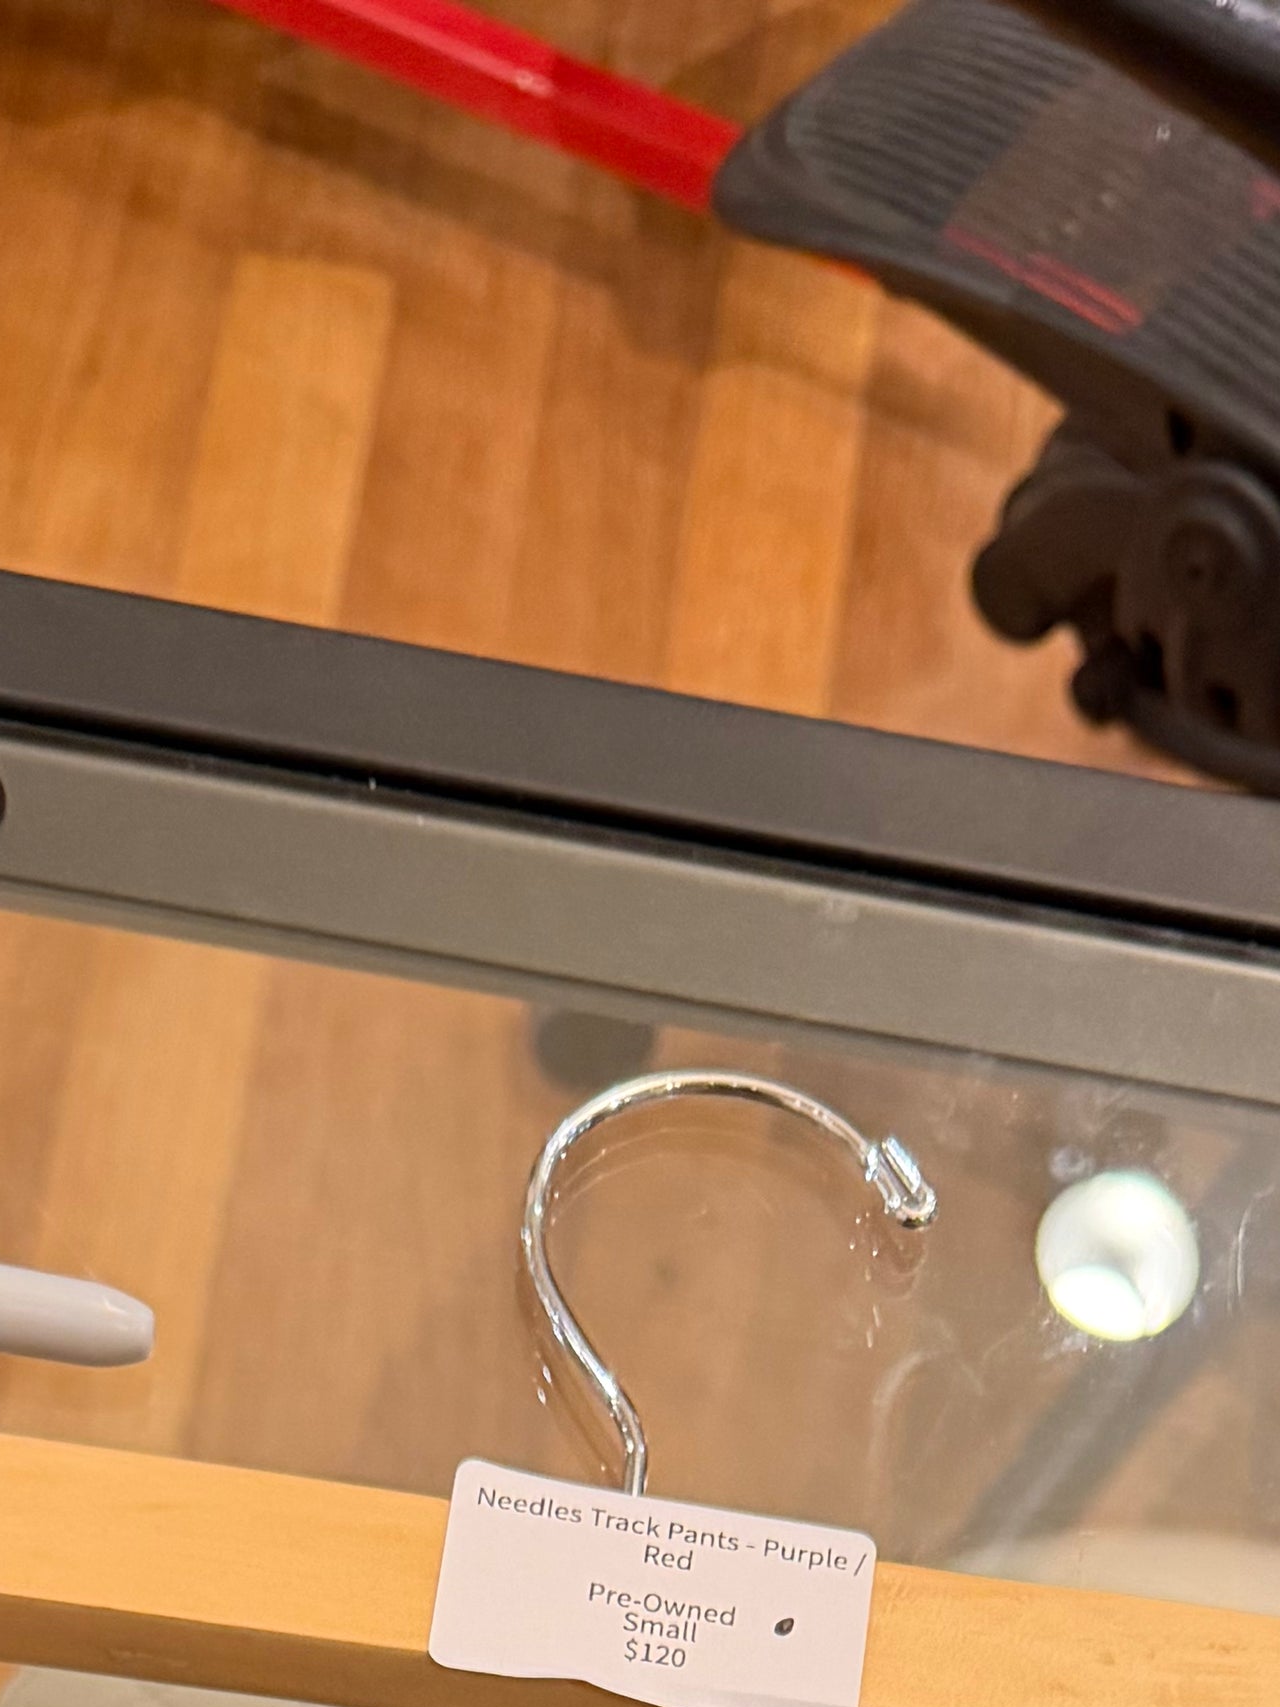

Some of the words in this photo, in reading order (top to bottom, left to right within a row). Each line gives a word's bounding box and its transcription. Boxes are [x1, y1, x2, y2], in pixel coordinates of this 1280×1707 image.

[477, 1487, 582, 1523] Needles
[591, 1508, 660, 1538] Track
[668, 1522, 739, 1552] Pants
[764, 1538, 848, 1571] Purple
[643, 1545, 693, 1571] Red
[588, 1582, 736, 1627] Pre-Owned
[623, 1612, 698, 1643] Small
[624, 1638, 686, 1669] $120
